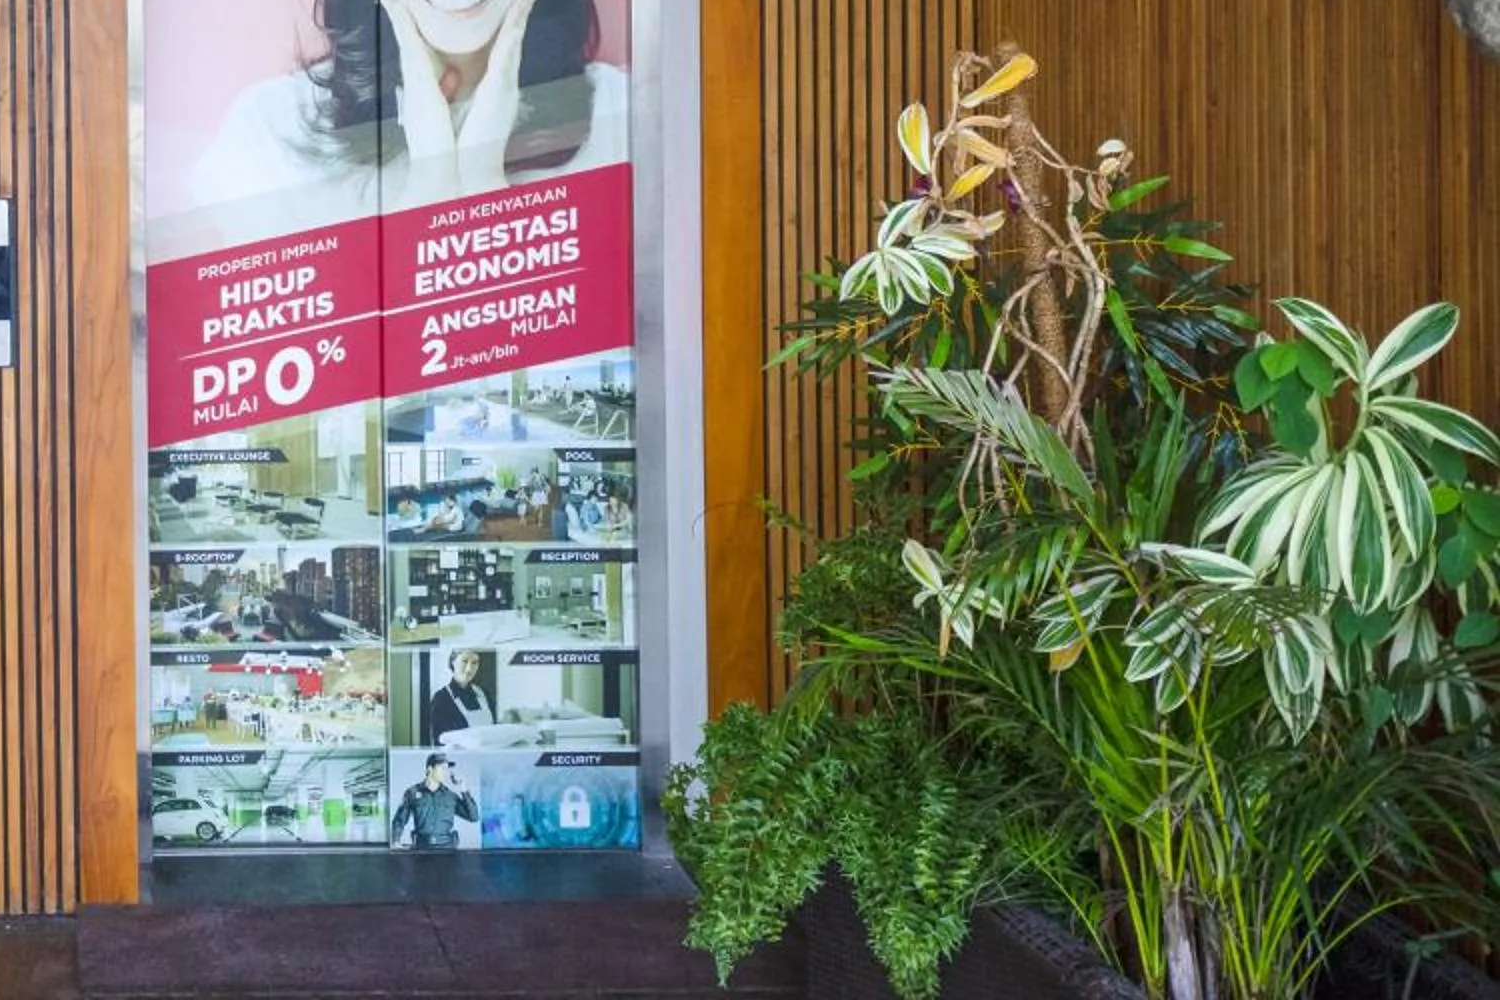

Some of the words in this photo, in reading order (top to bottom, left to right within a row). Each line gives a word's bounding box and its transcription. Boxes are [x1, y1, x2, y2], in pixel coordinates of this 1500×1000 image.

[428, 208, 466, 229] JADI
[468, 185, 567, 219] KENYATAAN
[416, 207, 578, 265] INVESTASI
[198, 250, 277, 280] PROPERTI
[281, 237, 338, 262] IMPIAN
[414, 237, 580, 296] EKONOMIS
[220, 266, 316, 308] HIDUP
[203, 292, 334, 343] PRAKTIS
[421, 284, 576, 338] ANGSURAN
[510, 308, 576, 337] MULAI
[193, 357, 257, 403] DP
[193, 395, 258, 425] MULAI
[169, 453, 224, 463] EXECUTIVE
[226, 452, 271, 461] LOUNGE
[565, 451, 595, 461] POOL
[541, 552, 600, 561] RECEPTION
[523, 653, 555, 663] ROOM
[557, 653, 601, 663] SERVICE
[178, 755, 224, 764] PARKING
[226, 754, 246, 763] LOT
[551, 756, 601, 765] SECURITY
